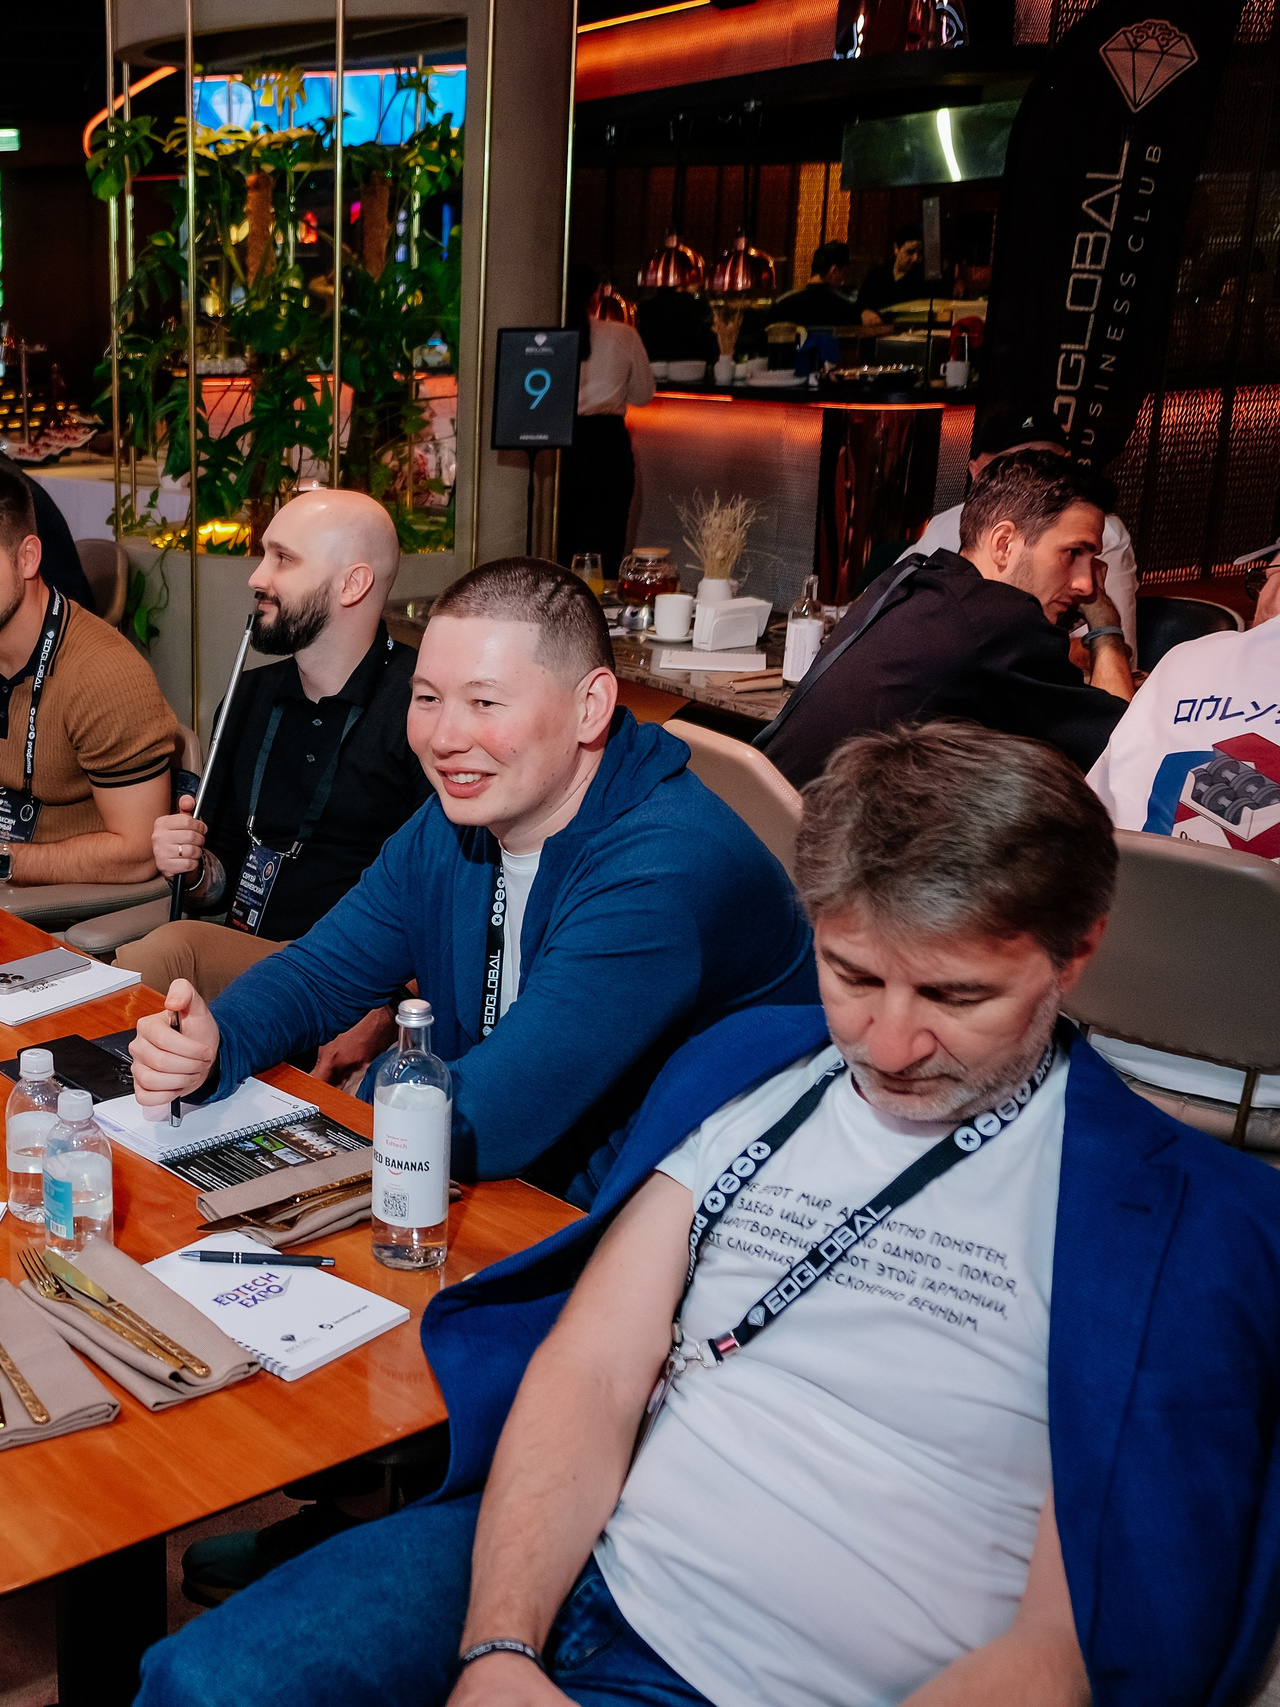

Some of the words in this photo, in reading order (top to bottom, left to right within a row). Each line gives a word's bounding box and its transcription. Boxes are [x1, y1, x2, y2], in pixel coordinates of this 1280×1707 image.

[1127, 145, 1162, 253] CLUB
[1052, 140, 1130, 433] DGLOBAL
[524, 367, 551, 411] 9
[34, 639, 53, 692] EDGLOBAL
[483, 949, 501, 1025] EDGLOBAL
[384, 1156, 430, 1172] BANANAS
[736, 1197, 775, 1217] ЗДЕСЬ
[780, 1207, 818, 1230] ИЩУ
[882, 1242, 942, 1271] ОДНОГО
[959, 1263, 1019, 1298] ПОКОЯ,
[765, 1204, 892, 1315] EDGLOBAL
[795, 1192, 833, 1212] МИР
[929, 1231, 1009, 1271] ПОНЯТЕН,
[212, 1272, 281, 1307] EDTECH
[238, 1284, 285, 1309] EXPO
[726, 1236, 796, 1268] СЛИЯНИЯ
[908, 1295, 979, 1334] ВЕЧНЫМ
[875, 1262, 917, 1287] ЭТОЙ
